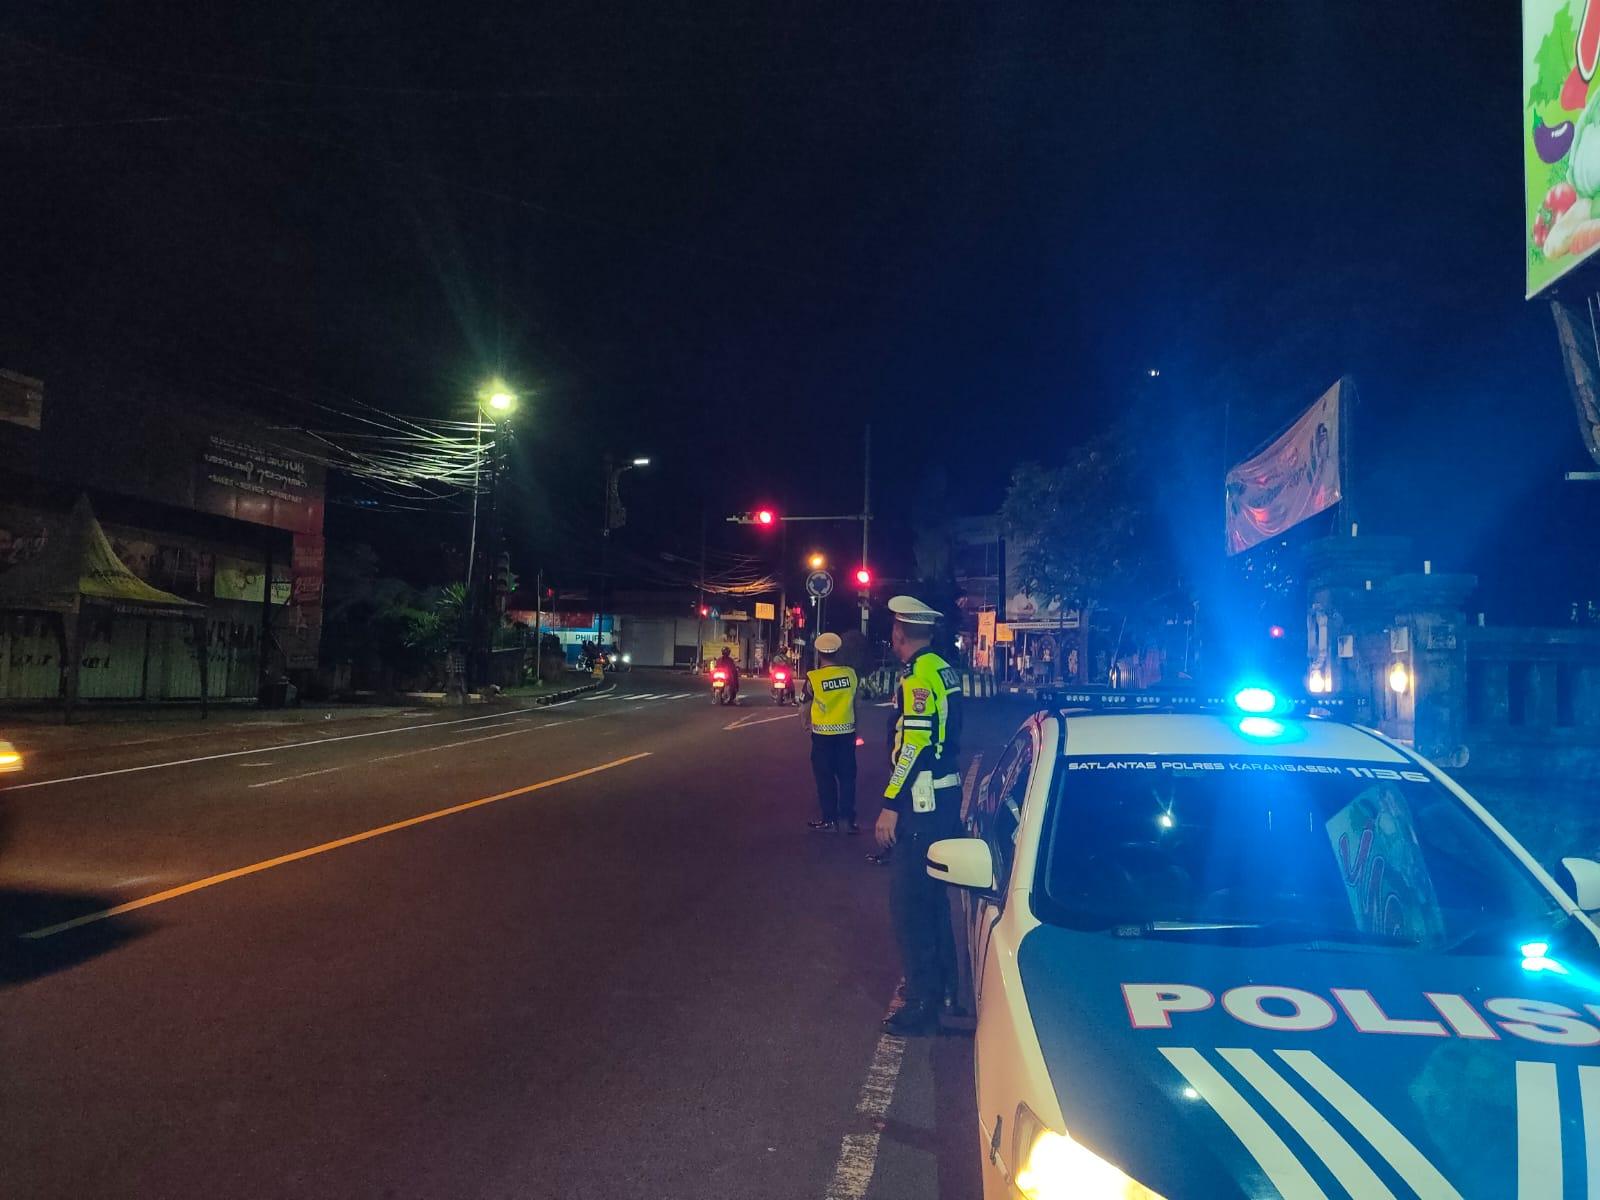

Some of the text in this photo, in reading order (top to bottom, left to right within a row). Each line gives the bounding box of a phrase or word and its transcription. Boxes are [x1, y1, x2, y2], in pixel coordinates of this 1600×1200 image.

[823, 678, 850, 690] POLISI
[890, 744, 917, 785] POLISI
[1068, 761, 1431, 783] SATLANTAS POLRES KARANGASEM 1136
[1121, 983, 1600, 1047] POLIS
